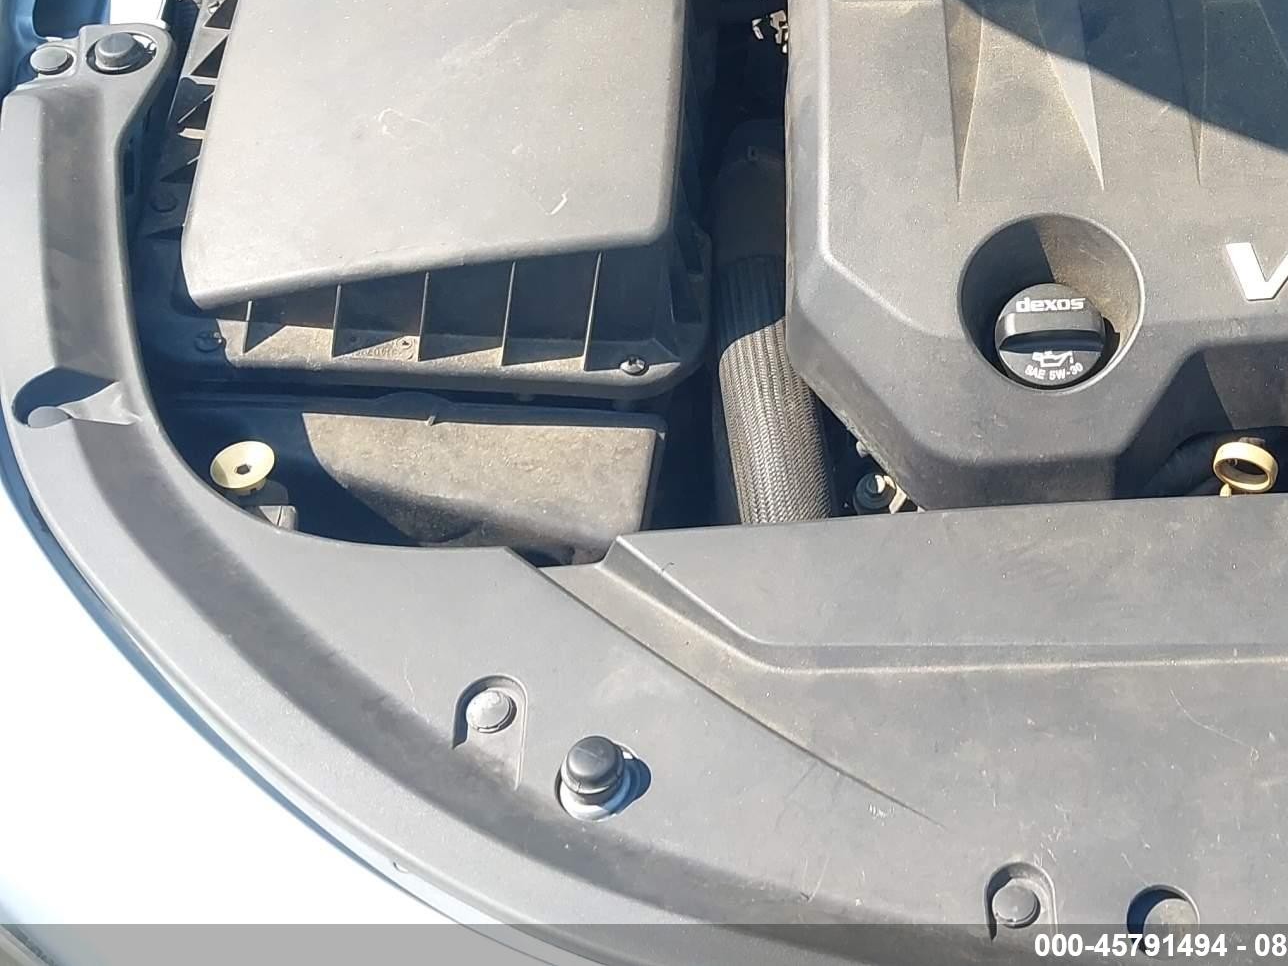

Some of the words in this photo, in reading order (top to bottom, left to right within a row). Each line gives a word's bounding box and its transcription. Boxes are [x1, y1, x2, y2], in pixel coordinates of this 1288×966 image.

[1015, 296, 1086, 313] dexos
[1024, 364, 1046, 380] SAE
[1048, 361, 1084, 381] 5W-30
